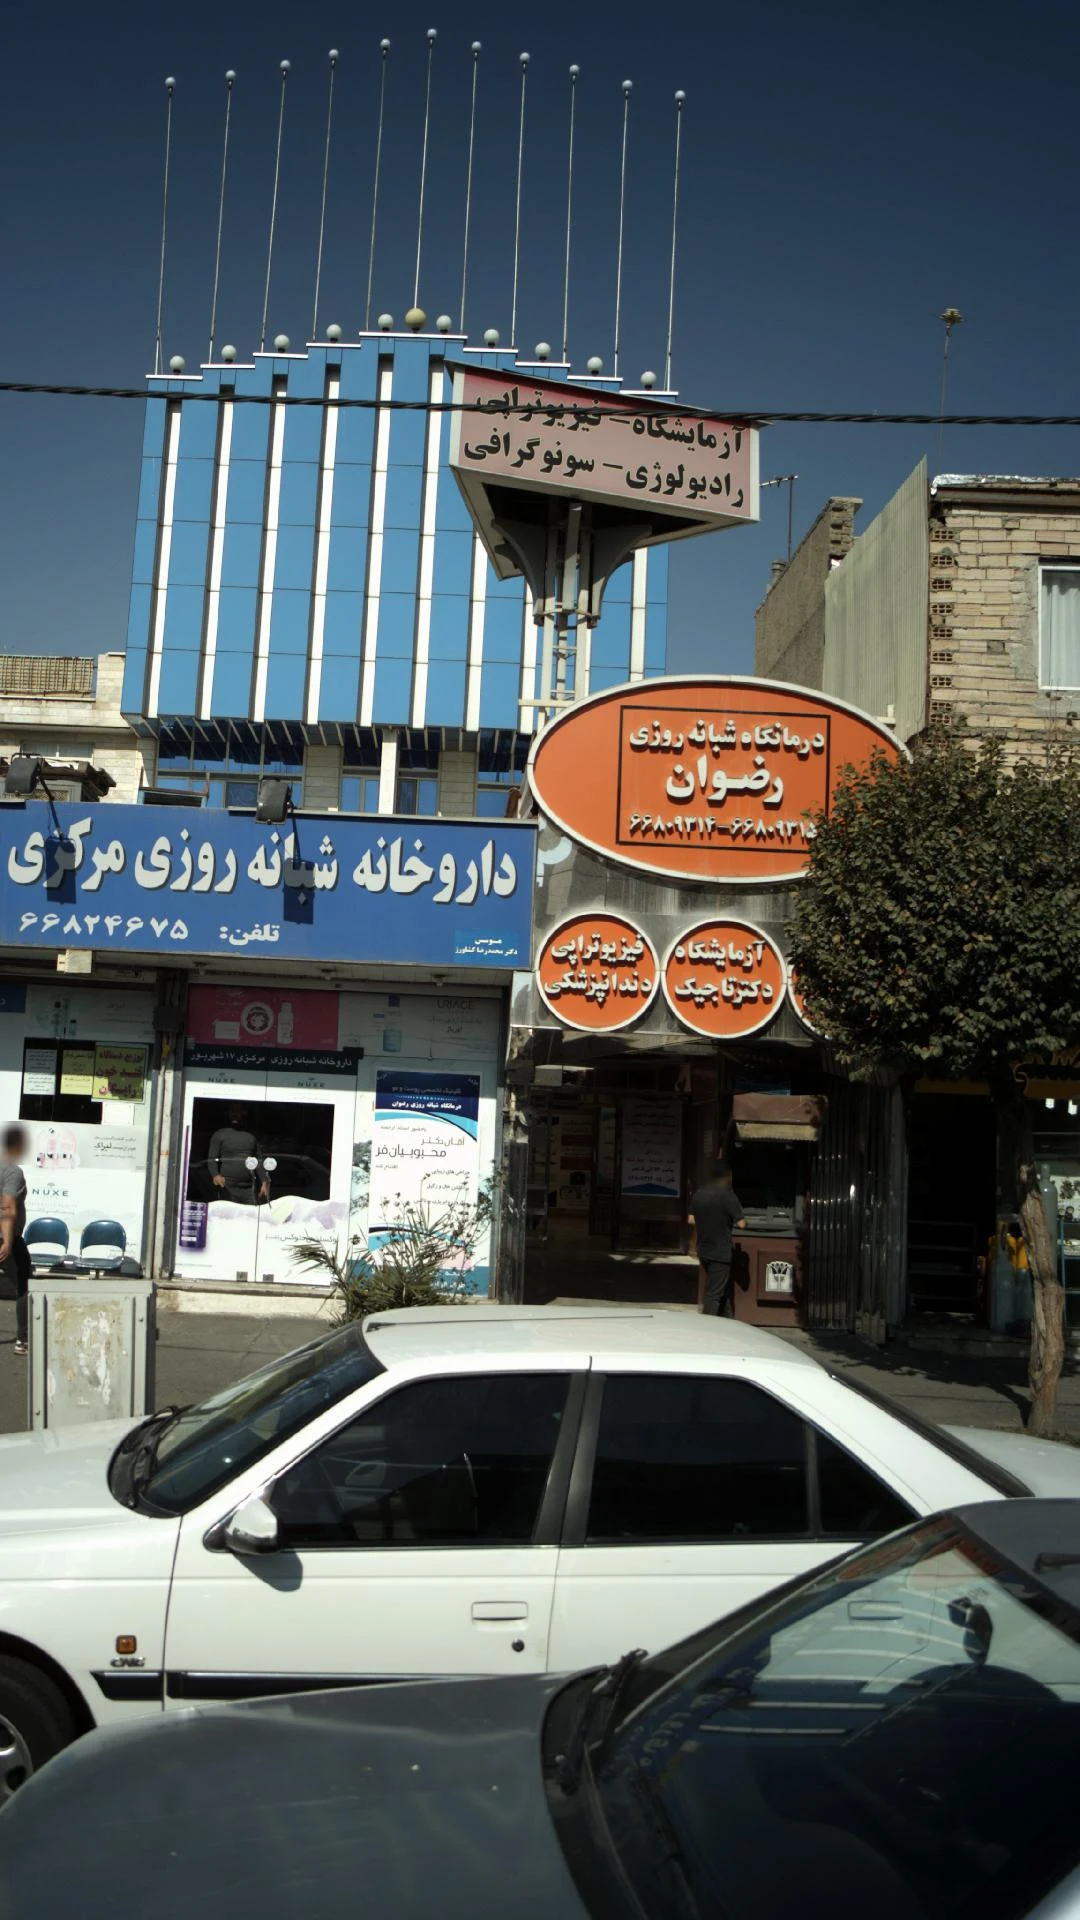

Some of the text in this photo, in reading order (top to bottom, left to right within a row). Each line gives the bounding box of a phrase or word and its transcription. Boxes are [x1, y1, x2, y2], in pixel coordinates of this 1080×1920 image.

[463, 427, 596, 478] سونوگرافی
[633, 415, 746, 460] آزمایشگاه
[626, 462, 744, 508] رادیولوژی
[629, 719, 825, 755] درمانگاه شبانه روزی
[666, 753, 784, 804] رضوان
[7, 816, 518, 905] داروخانه شبانه روزی مرکزی
[18, 911, 281, 946] تلفن: ۶۶۸۲۴۶۷۵
[551, 933, 645, 965] فیزیوتراپی
[674, 938, 766, 967] آزمایشگاه
[544, 969, 653, 1003] دندانپزشکی
[674, 976, 774, 1003] دکتر تاجیک
[190, 1052, 225, 1062] شهریور
[236, 1053, 266, 1064] مرکزی
[270, 1055, 294, 1066] روزی
[294, 1056, 317, 1065] شبانه
[318, 1058, 352, 1069] داروخانه
[32, 1188, 69, 1197] NUXE
